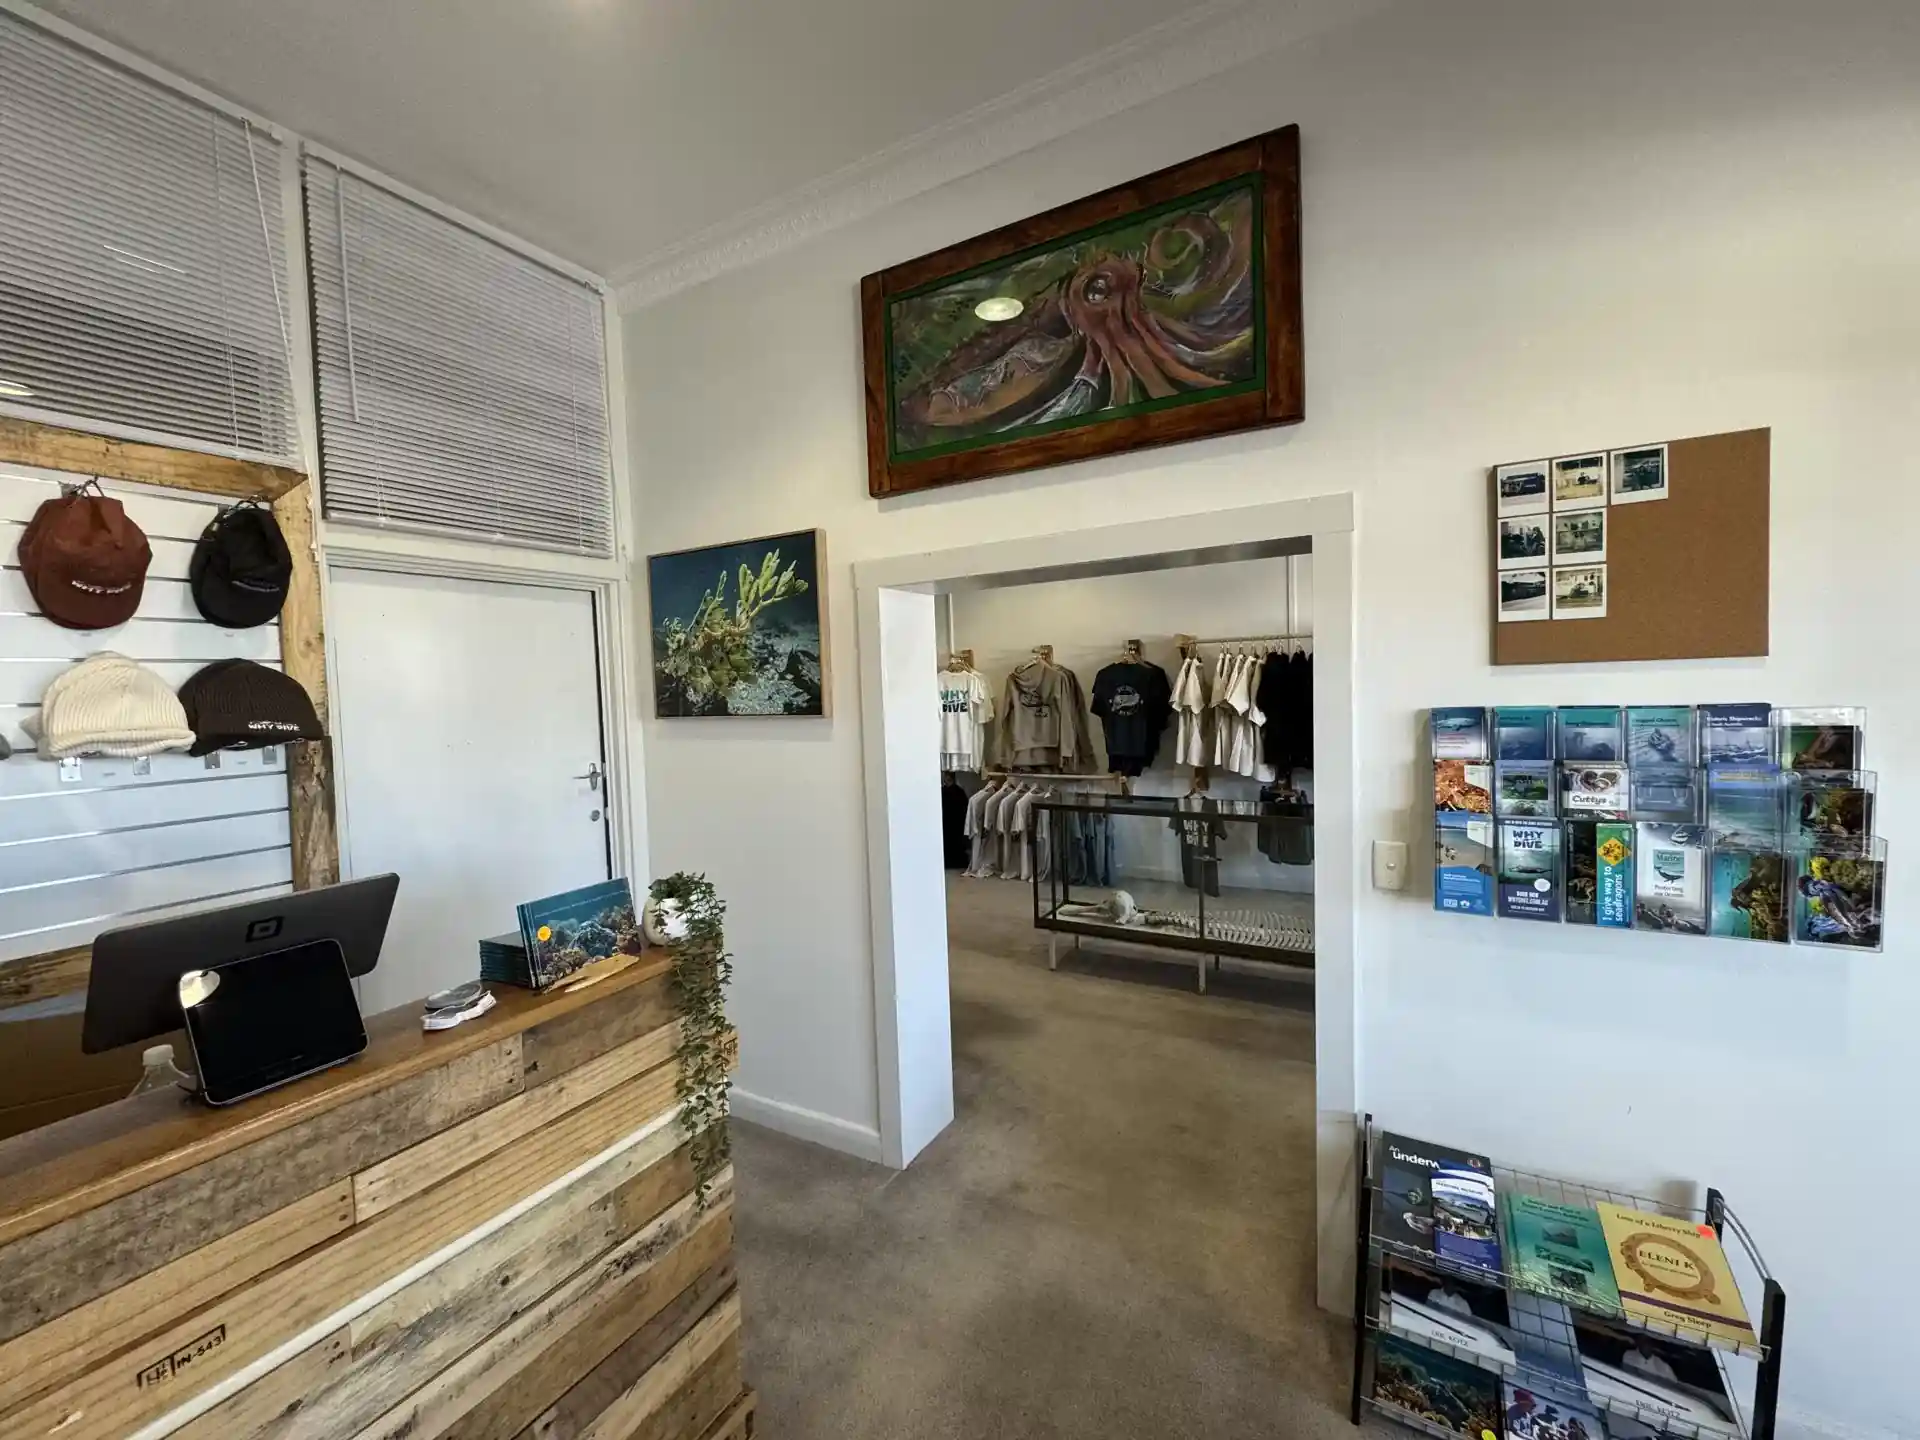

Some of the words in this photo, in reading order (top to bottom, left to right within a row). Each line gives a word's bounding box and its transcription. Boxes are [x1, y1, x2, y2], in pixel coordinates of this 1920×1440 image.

[940, 690, 968, 700] WHY
[942, 703, 968, 713] DIVE
[1513, 830, 1544, 838] WHY
[1514, 840, 1543, 848] DIVE
[1603, 865, 1613, 876] to
[1603, 877, 1615, 896] way
[1612, 874, 1627, 922] seadragons
[1602, 895, 1615, 915] give
[1635, 1218, 1643, 1226] of
[1652, 1222, 1681, 1234] Liberty
[1640, 1250, 1680, 1266] ELENI
[1684, 1261, 1695, 1271] K
[1664, 1310, 1686, 1323] Greg
